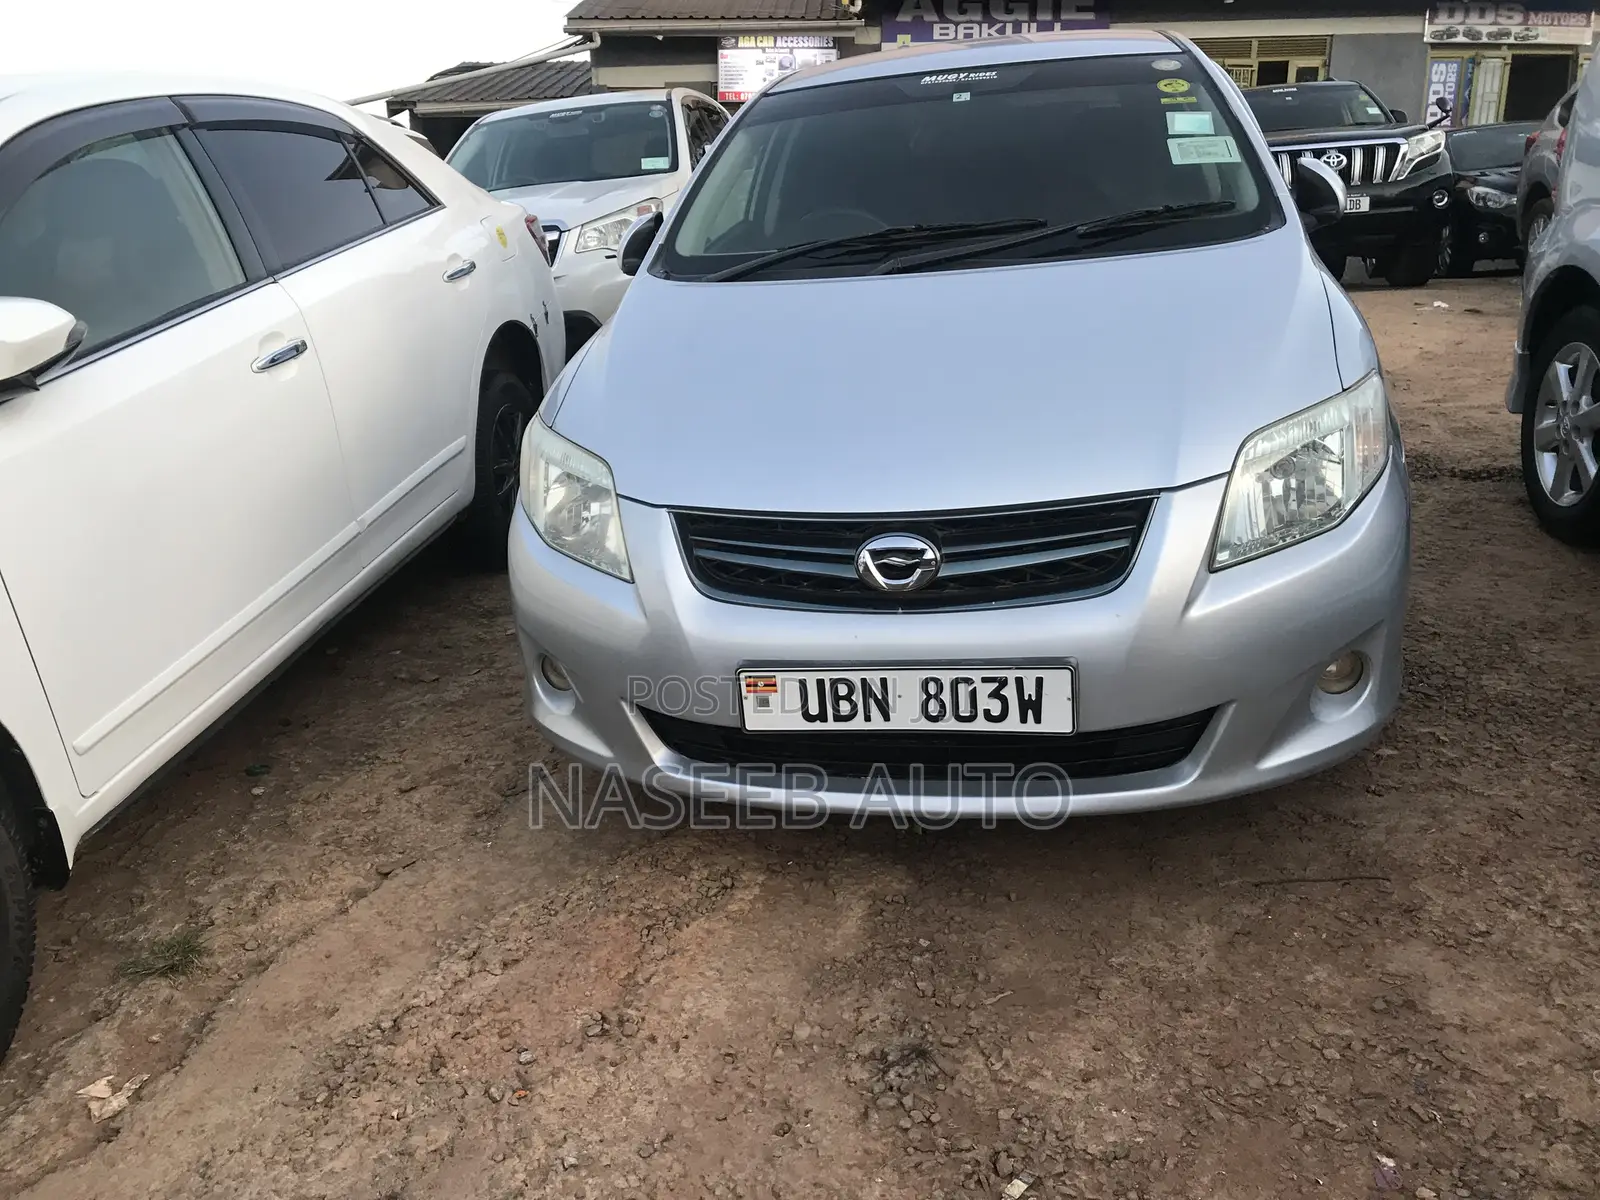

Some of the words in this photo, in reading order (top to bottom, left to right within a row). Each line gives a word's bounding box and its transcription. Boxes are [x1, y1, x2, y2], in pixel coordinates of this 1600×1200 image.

[1528, 11, 1588, 26] MOTORS
[738, 36, 756, 48] AGA
[757, 36, 775, 48] CAR
[776, 36, 834, 48] ACCESSORIES
[799, 676, 892, 724] UBN
[920, 675, 1045, 725] 803W
